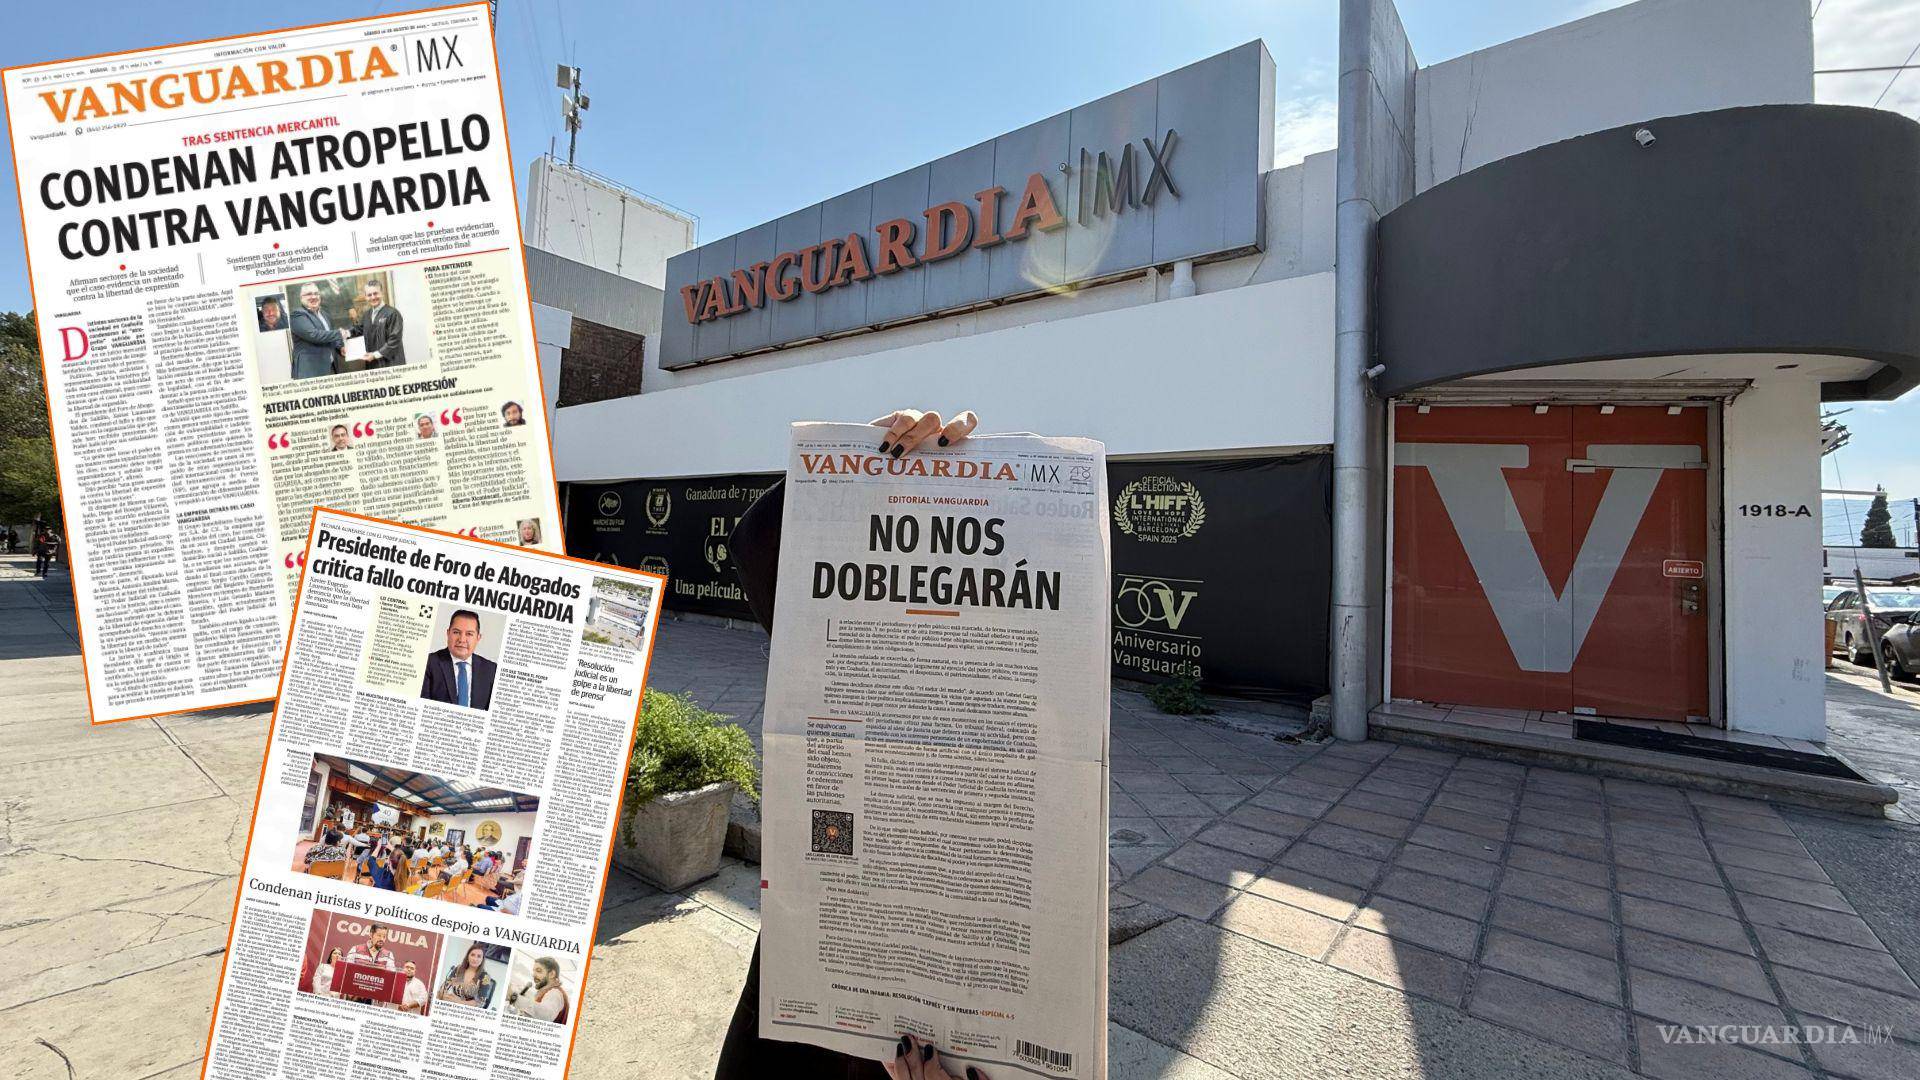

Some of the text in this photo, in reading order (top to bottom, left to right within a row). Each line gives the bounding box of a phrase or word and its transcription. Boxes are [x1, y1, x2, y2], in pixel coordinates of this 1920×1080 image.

[38, 34, 463, 123] VANGUARDIA MX
[181, 116, 339, 146] TRAS SENTENCIA MERCANTIL
[40, 113, 489, 210] CONDENAN ATROPELLO
[58, 166, 490, 259] CONTRA VANGUARDIA
[369, 234, 398, 244] Señalan
[414, 231, 424, 239] las
[426, 227, 454, 237] pruebas
[455, 222, 494, 233] evidencian
[381, 237, 431, 250] interpretación
[432, 235, 459, 244] errónea
[471, 228, 499, 237] acuerdo
[226, 245, 328, 266] Sostienen que caso evidencia
[420, 242, 453, 253] resultado
[453, 239, 470, 248] final
[680, 172, 1066, 324] VANGUARDIA
[232, 252, 323, 271] irregularidades dentro del
[255, 262, 303, 276] Poder Judicial
[441, 260, 472, 270] ENTENDER
[69, 277, 98, 286] Afirman
[98, 271, 127, 282] sectores
[129, 270, 138, 279] de
[147, 264, 178, 276] sociedad
[81, 285, 87, 294] el
[106, 278, 140, 291] evidencia
[152, 272, 184, 282] atentado
[73, 279, 179, 302] contra la libertad de expresión
[301, 393, 340, 408] CONTRA
[342, 387, 386, 403] LIBERTAD
[388, 385, 401, 396] DE
[800, 454, 1018, 481] VANGUARDIA
[1030, 464, 1060, 484] MX
[1142, 476, 1175, 484] OFFICIAL
[686, 484, 769, 502] Ganadora de 7 pre
[888, 496, 989, 506] EDITORIAL VANGUARDIA
[1130, 494, 1189, 510] L'HIFF
[1738, 504, 1812, 518] 1918-A
[711, 517, 728, 536] EL
[869, 514, 1006, 556] NO NOS
[1161, 535, 1178, 543] 2025
[317, 529, 580, 598] Presidente de Foro de Abogados
[1394, 443, 1701, 672] V
[1668, 566, 1699, 574] ABIERTO
[366, 564, 403, 589] fallo
[406, 577, 459, 600] contra
[464, 584, 572, 623] VANGUARDIA
[675, 579, 741, 600] Una película
[812, 558, 1061, 611] DOBLEGARÁN
[1114, 631, 1201, 658] Aniversario
[574, 668, 598, 679] judicial
[1114, 649, 1201, 678] Vanguardia
[570, 687, 580, 696] de
[572, 679, 591, 688] golpe
[598, 682, 604, 690] la
[605, 684, 632, 696] libertad
[249, 877, 579, 953] Condenan juristas y políticos despojo a VANGUARDIA
[335, 918, 430, 949] COAUILA
[353, 971, 385, 984] morena
